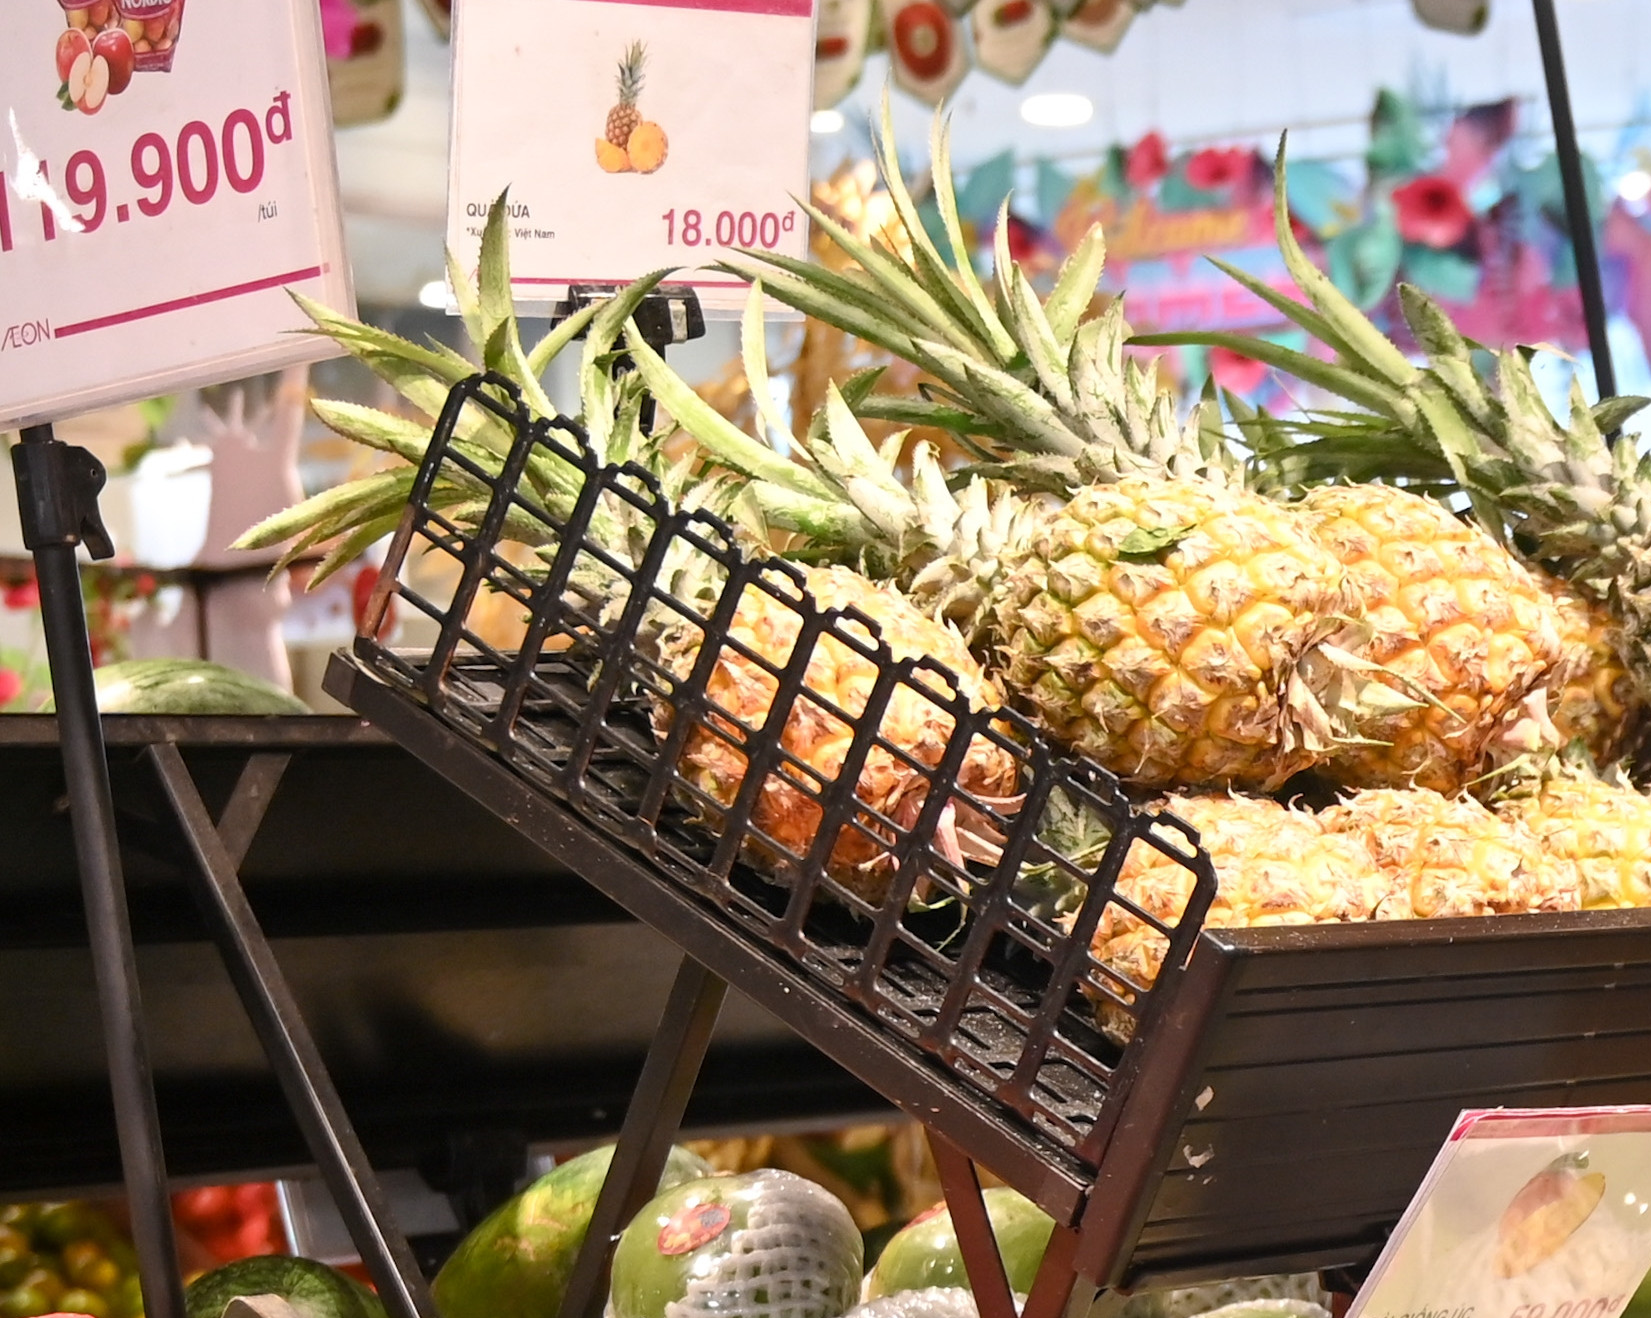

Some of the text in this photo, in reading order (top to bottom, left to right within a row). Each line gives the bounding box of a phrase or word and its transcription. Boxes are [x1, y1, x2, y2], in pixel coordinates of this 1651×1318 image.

[258, 201, 279, 223] /túi
[534, 229, 555, 239] Nam
[662, 207, 796, 248] 18.000đ
